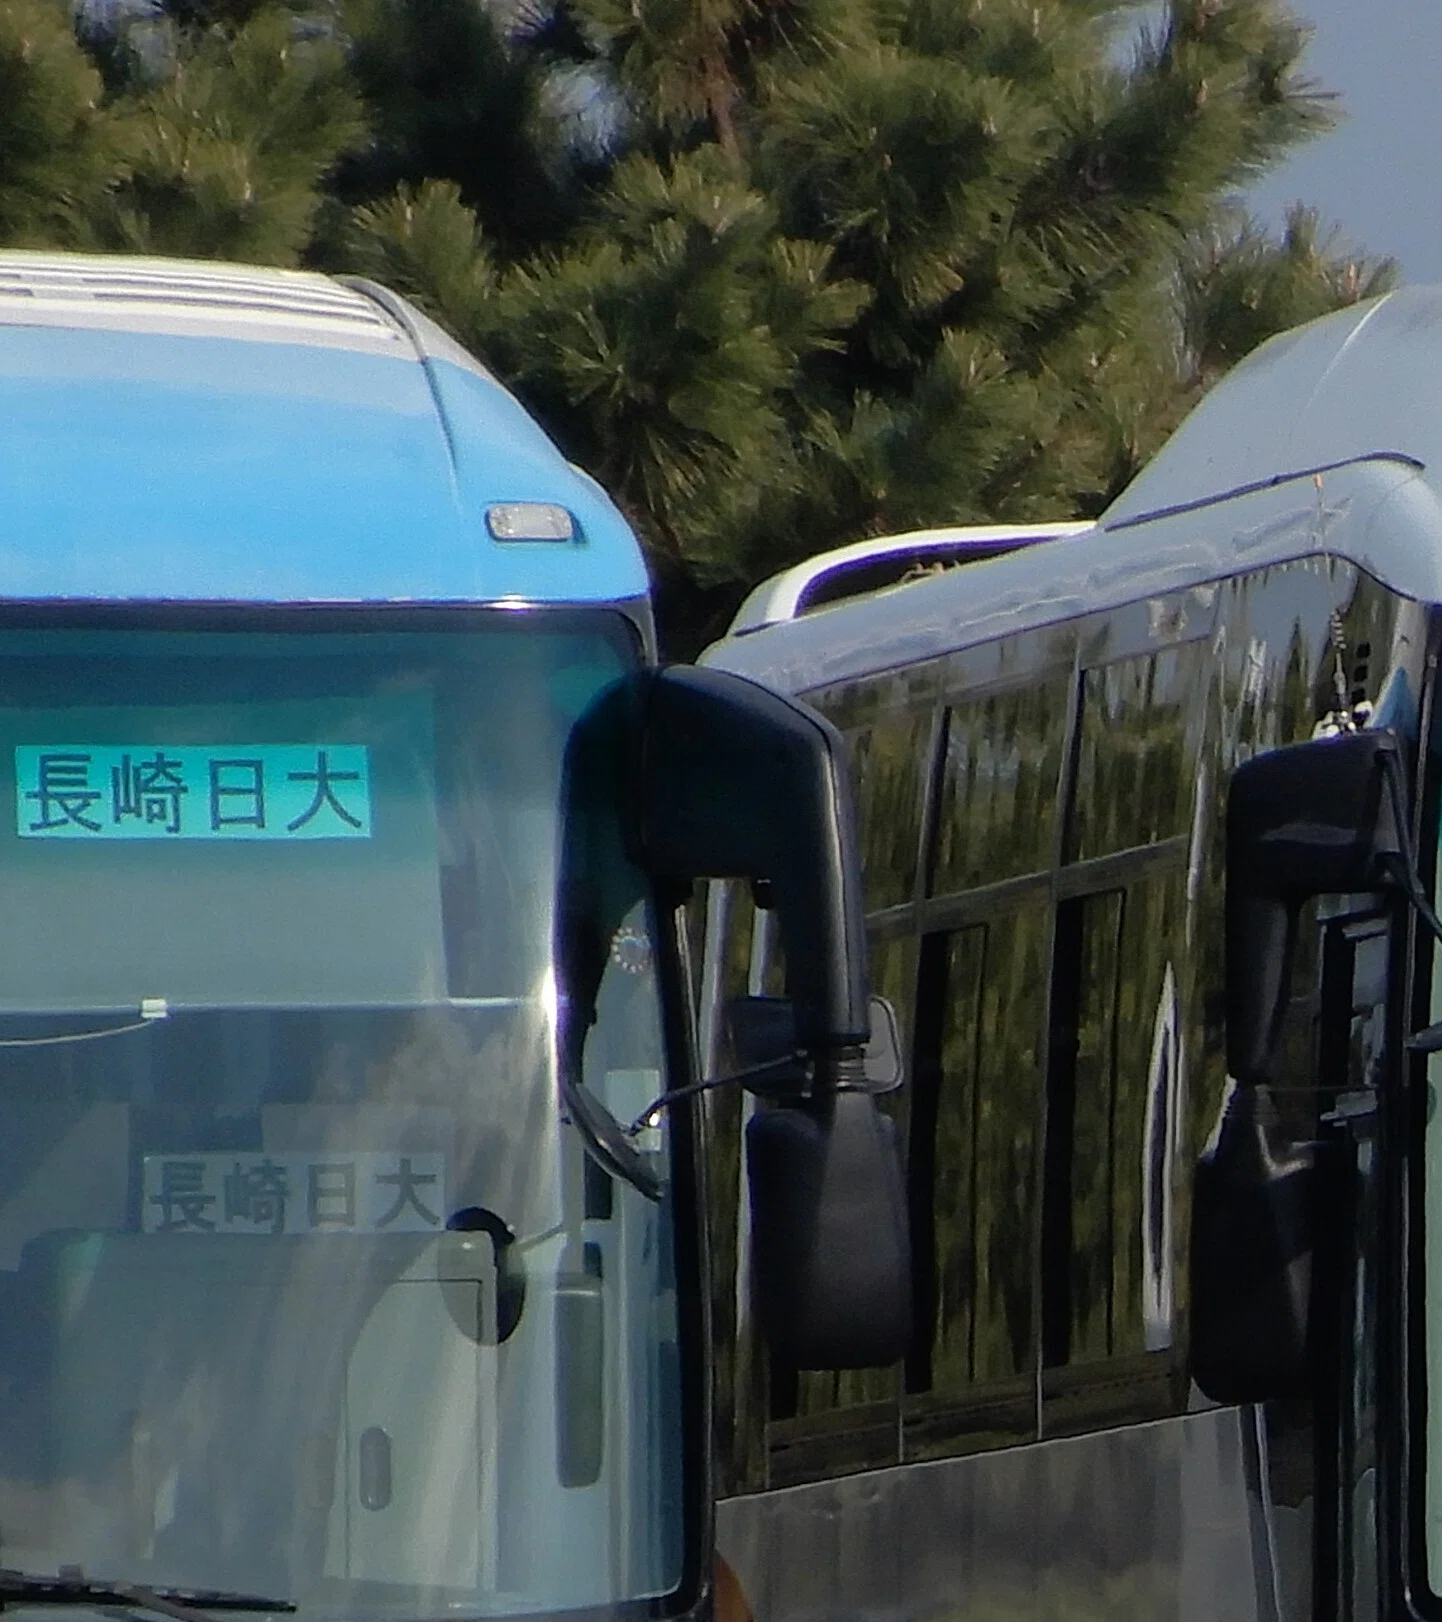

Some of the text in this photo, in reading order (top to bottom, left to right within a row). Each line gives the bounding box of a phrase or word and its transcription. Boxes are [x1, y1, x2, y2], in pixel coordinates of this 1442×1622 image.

[26, 751, 363, 833] 長崎日大
[150, 1156, 440, 1233] 長崎日大
